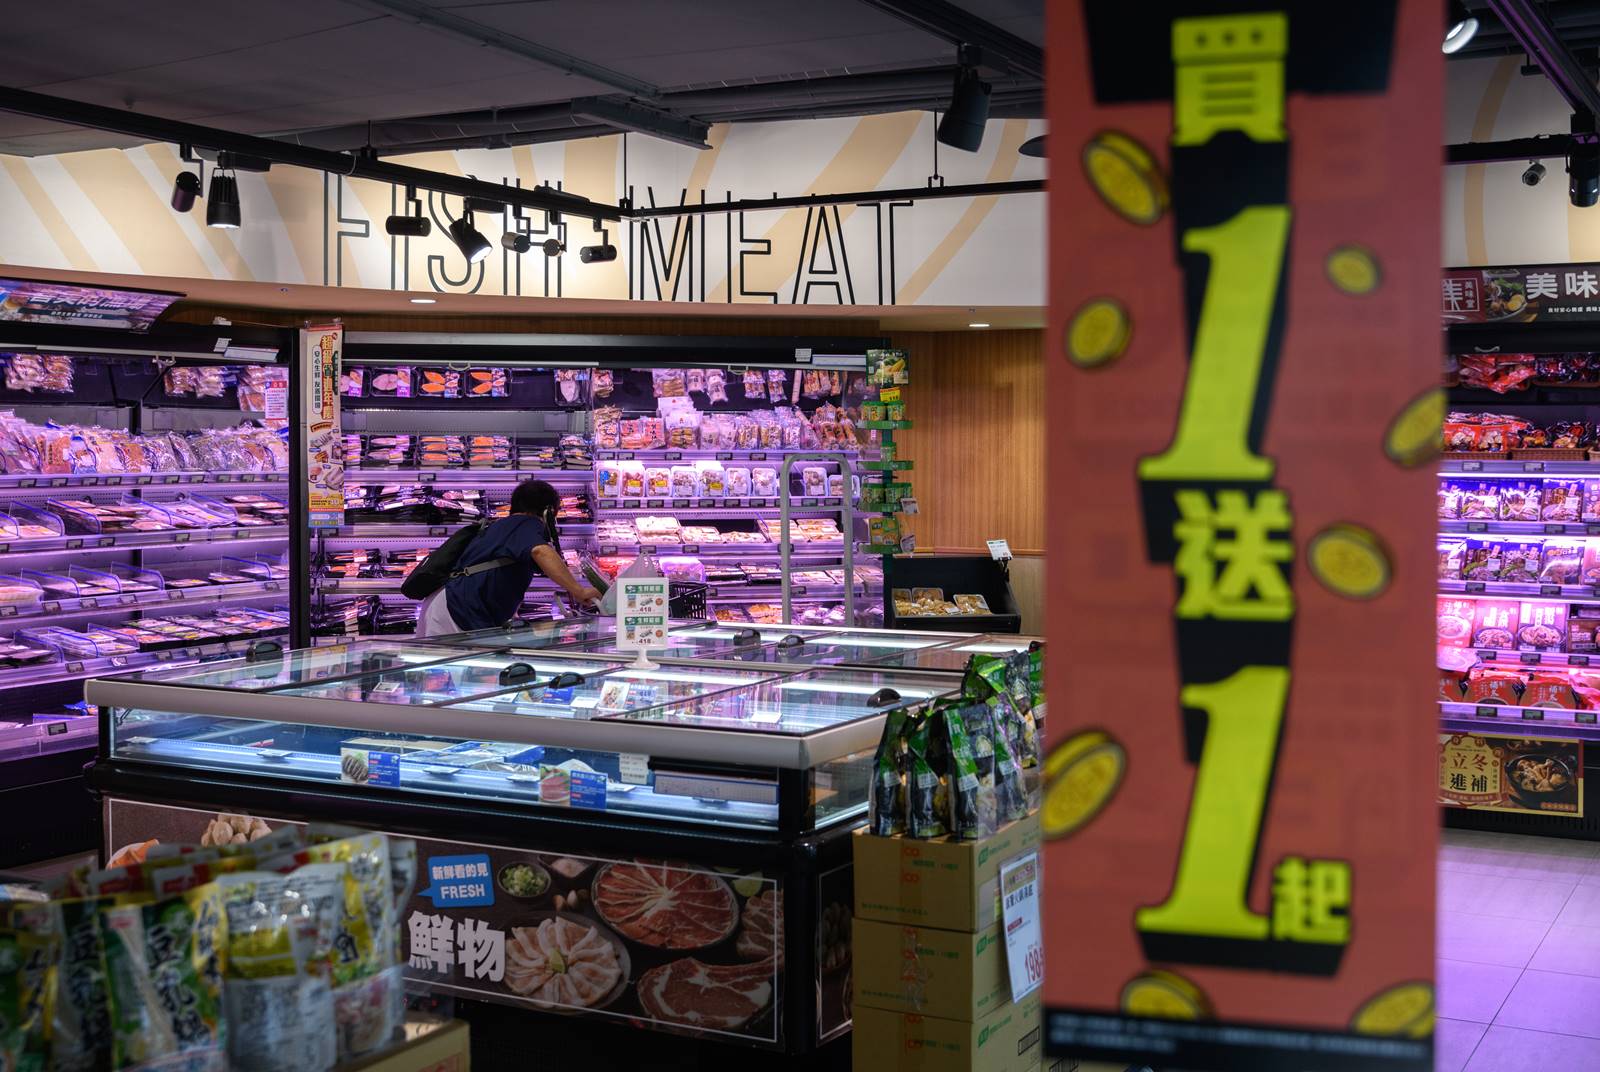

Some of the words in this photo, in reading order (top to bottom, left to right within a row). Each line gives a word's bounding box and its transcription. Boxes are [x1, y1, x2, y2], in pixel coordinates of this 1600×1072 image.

[629, 184, 914, 306] MEAT
[1525, 270, 1599, 300] 美味
[1138, 11, 1352, 944] 買1送1起
[1450, 752, 1489, 772] 立冬
[1449, 772, 1489, 793] 進補
[432, 862, 489, 880] 新鮮看的見
[440, 883, 486, 899] FRESH
[407, 910, 506, 983] 鮮物
